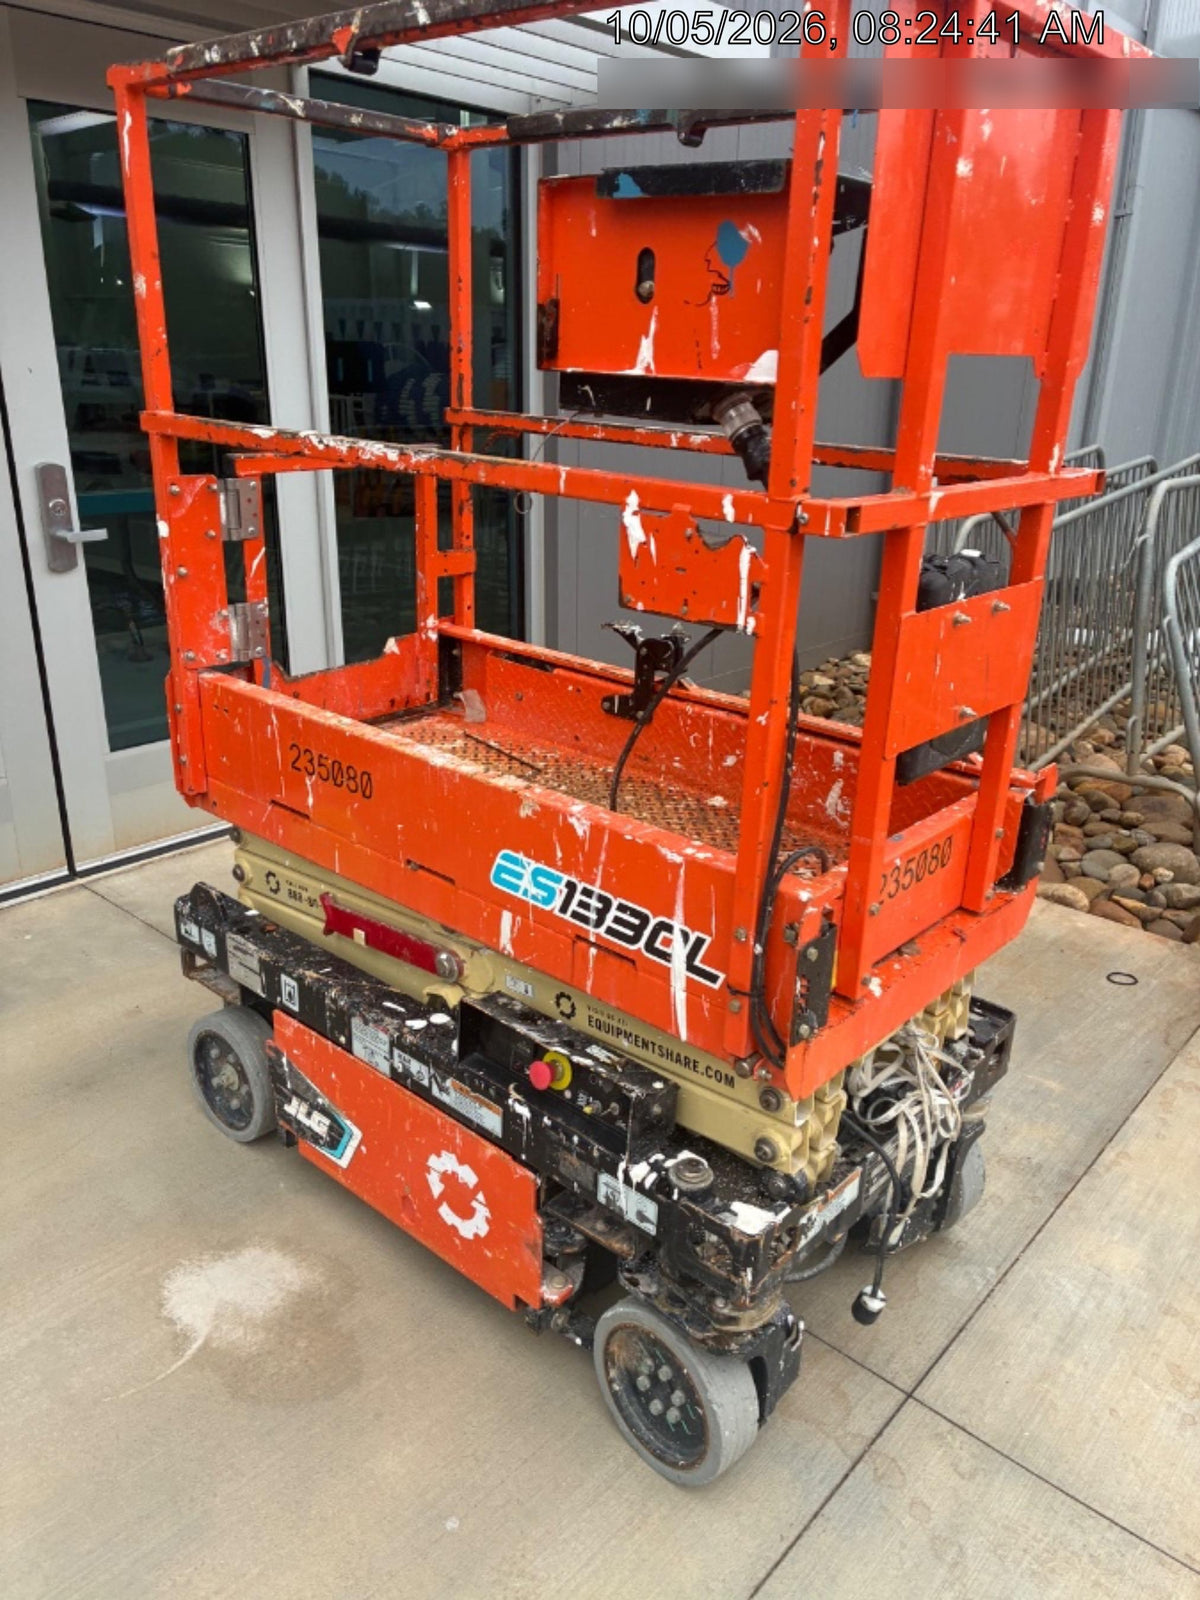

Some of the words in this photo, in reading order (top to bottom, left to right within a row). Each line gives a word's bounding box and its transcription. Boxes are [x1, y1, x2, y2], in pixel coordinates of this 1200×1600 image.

[289, 743, 373, 799] 235080
[587, 1014, 736, 1089] EQUIPMENTSHARE.COM
[283, 1095, 332, 1137] JLG
